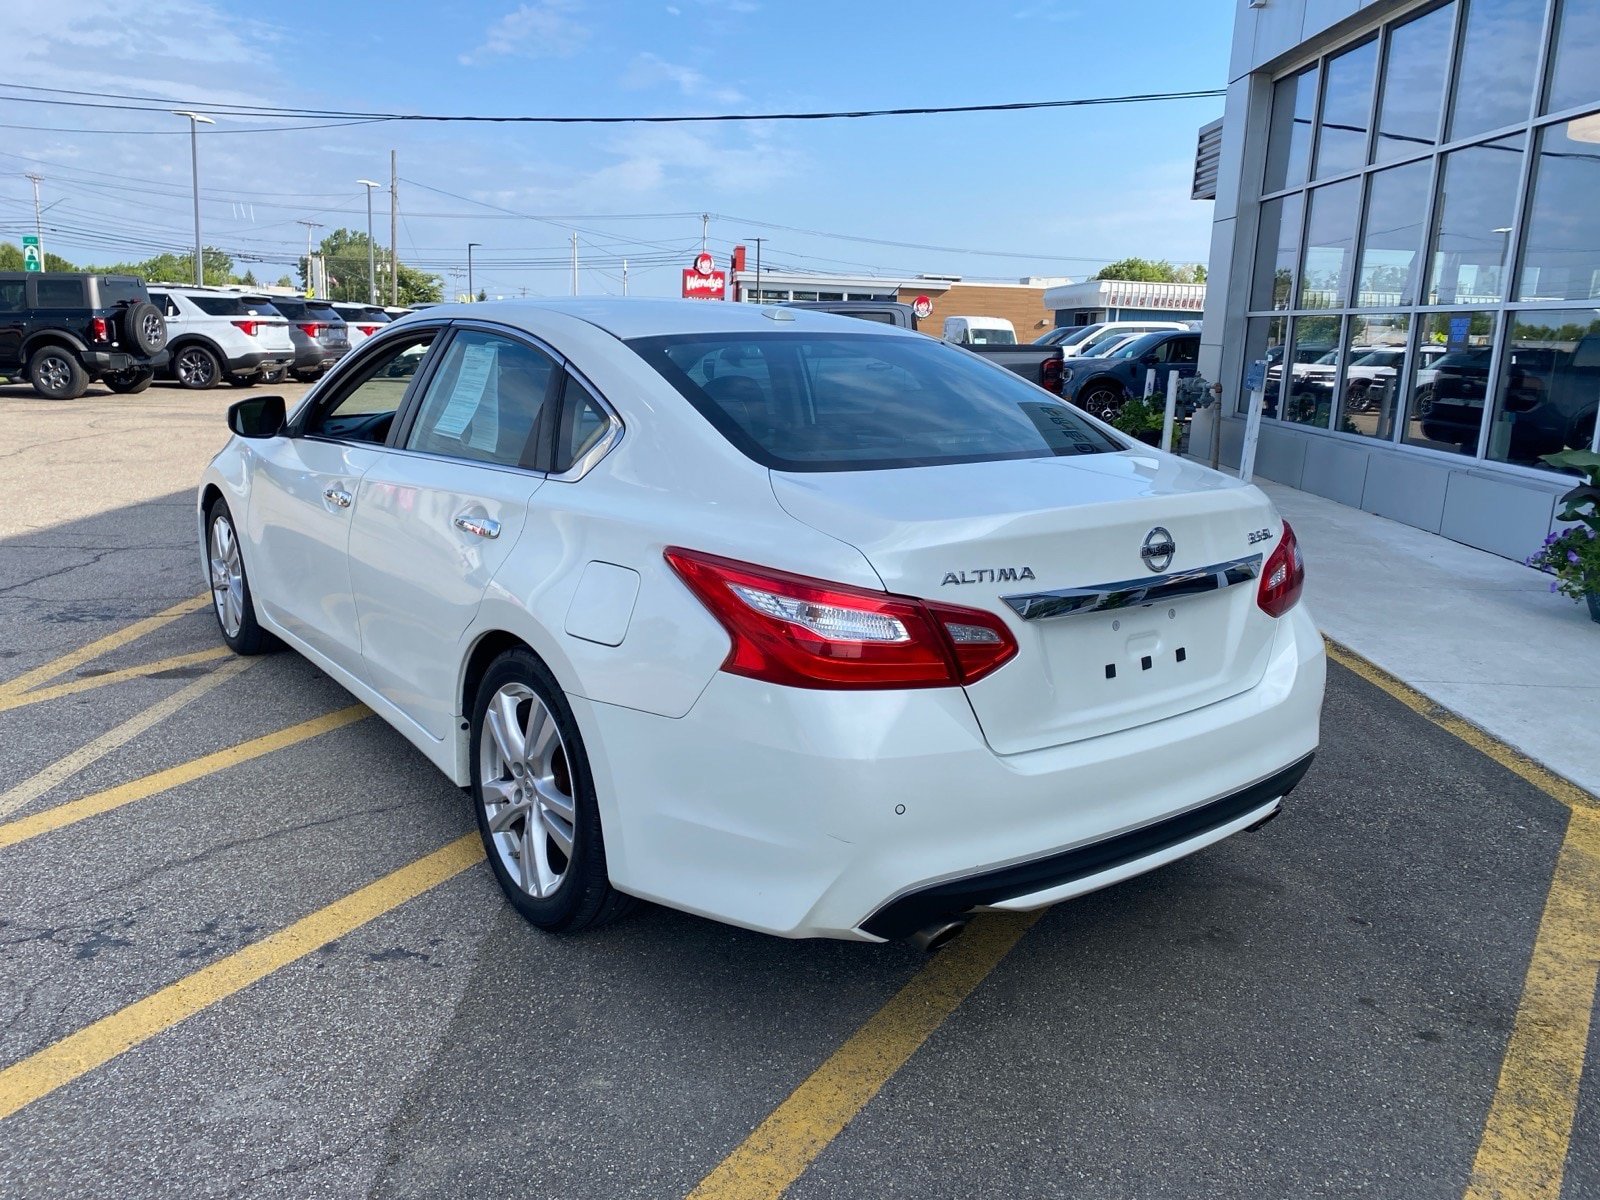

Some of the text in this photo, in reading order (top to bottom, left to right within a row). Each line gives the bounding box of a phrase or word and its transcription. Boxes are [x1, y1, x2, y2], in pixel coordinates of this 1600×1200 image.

[686, 274, 724, 292] Wendy's
[1142, 543, 1175, 557] NISSAN
[941, 566, 1036, 586] ALTIMA
